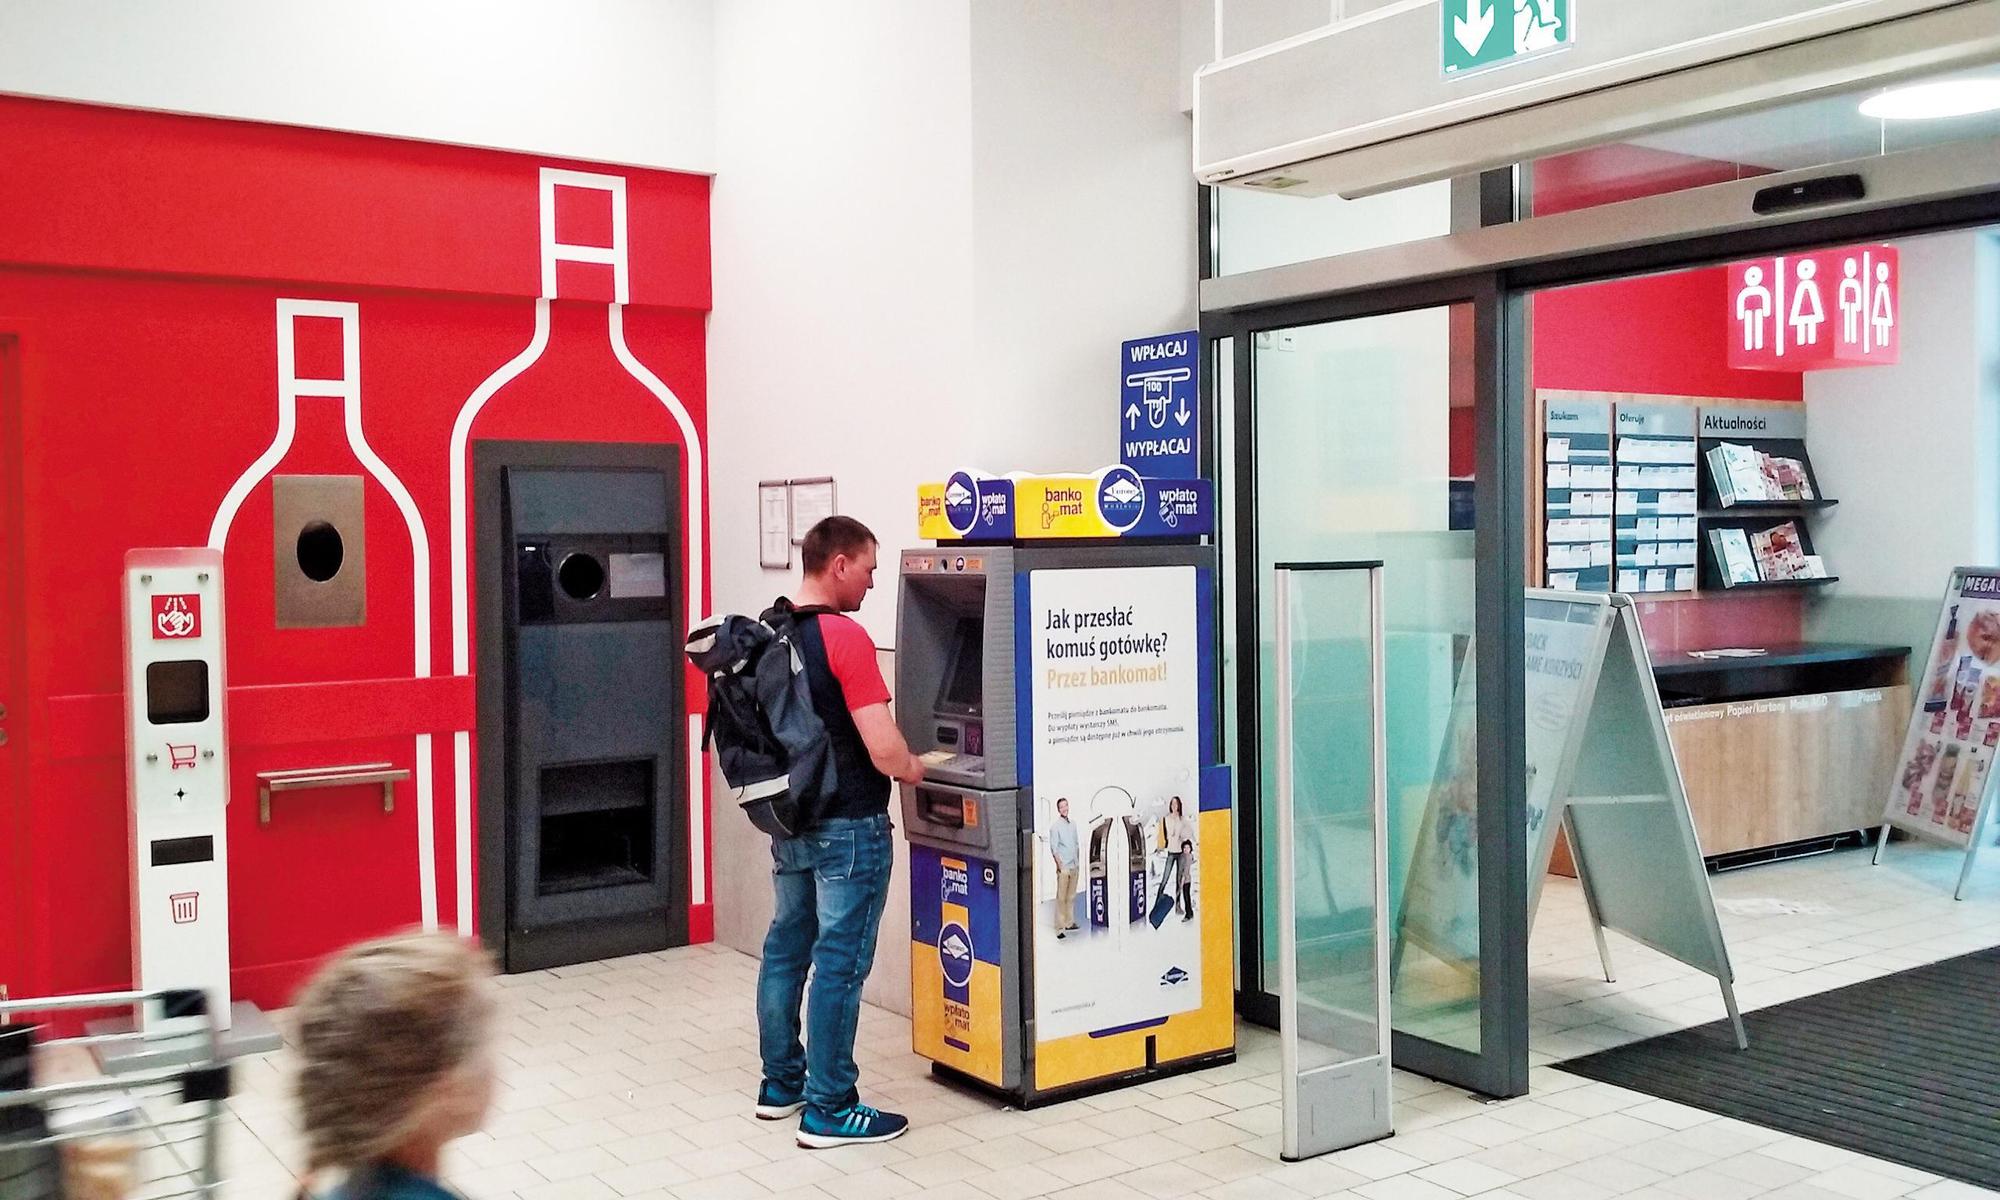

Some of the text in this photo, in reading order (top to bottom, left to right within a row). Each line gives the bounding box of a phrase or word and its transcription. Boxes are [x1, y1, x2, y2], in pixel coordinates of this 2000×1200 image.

[1131, 340, 1188, 362] WPŁACAJ
[1550, 411, 1579, 421] Szukam
[1619, 413, 1645, 424] Oferuję
[1704, 415, 1767, 430] Aktualności
[1125, 438, 1191, 458] WYPŁACAJ
[1045, 487, 1082, 502] banko
[1159, 488, 1198, 503] wpłato
[992, 504, 1006, 515] mat
[1060, 502, 1082, 515] mat
[1175, 502, 1198, 515] mat
[1046, 605, 1133, 633] Jak przesłać
[1047, 632, 1168, 661] komuś gotówkę?
[1047, 661, 1167, 689] Przez bankomat!
[943, 867, 968, 884] banko
[952, 881, 968, 896] mat
[954, 1016, 970, 1032] mat
